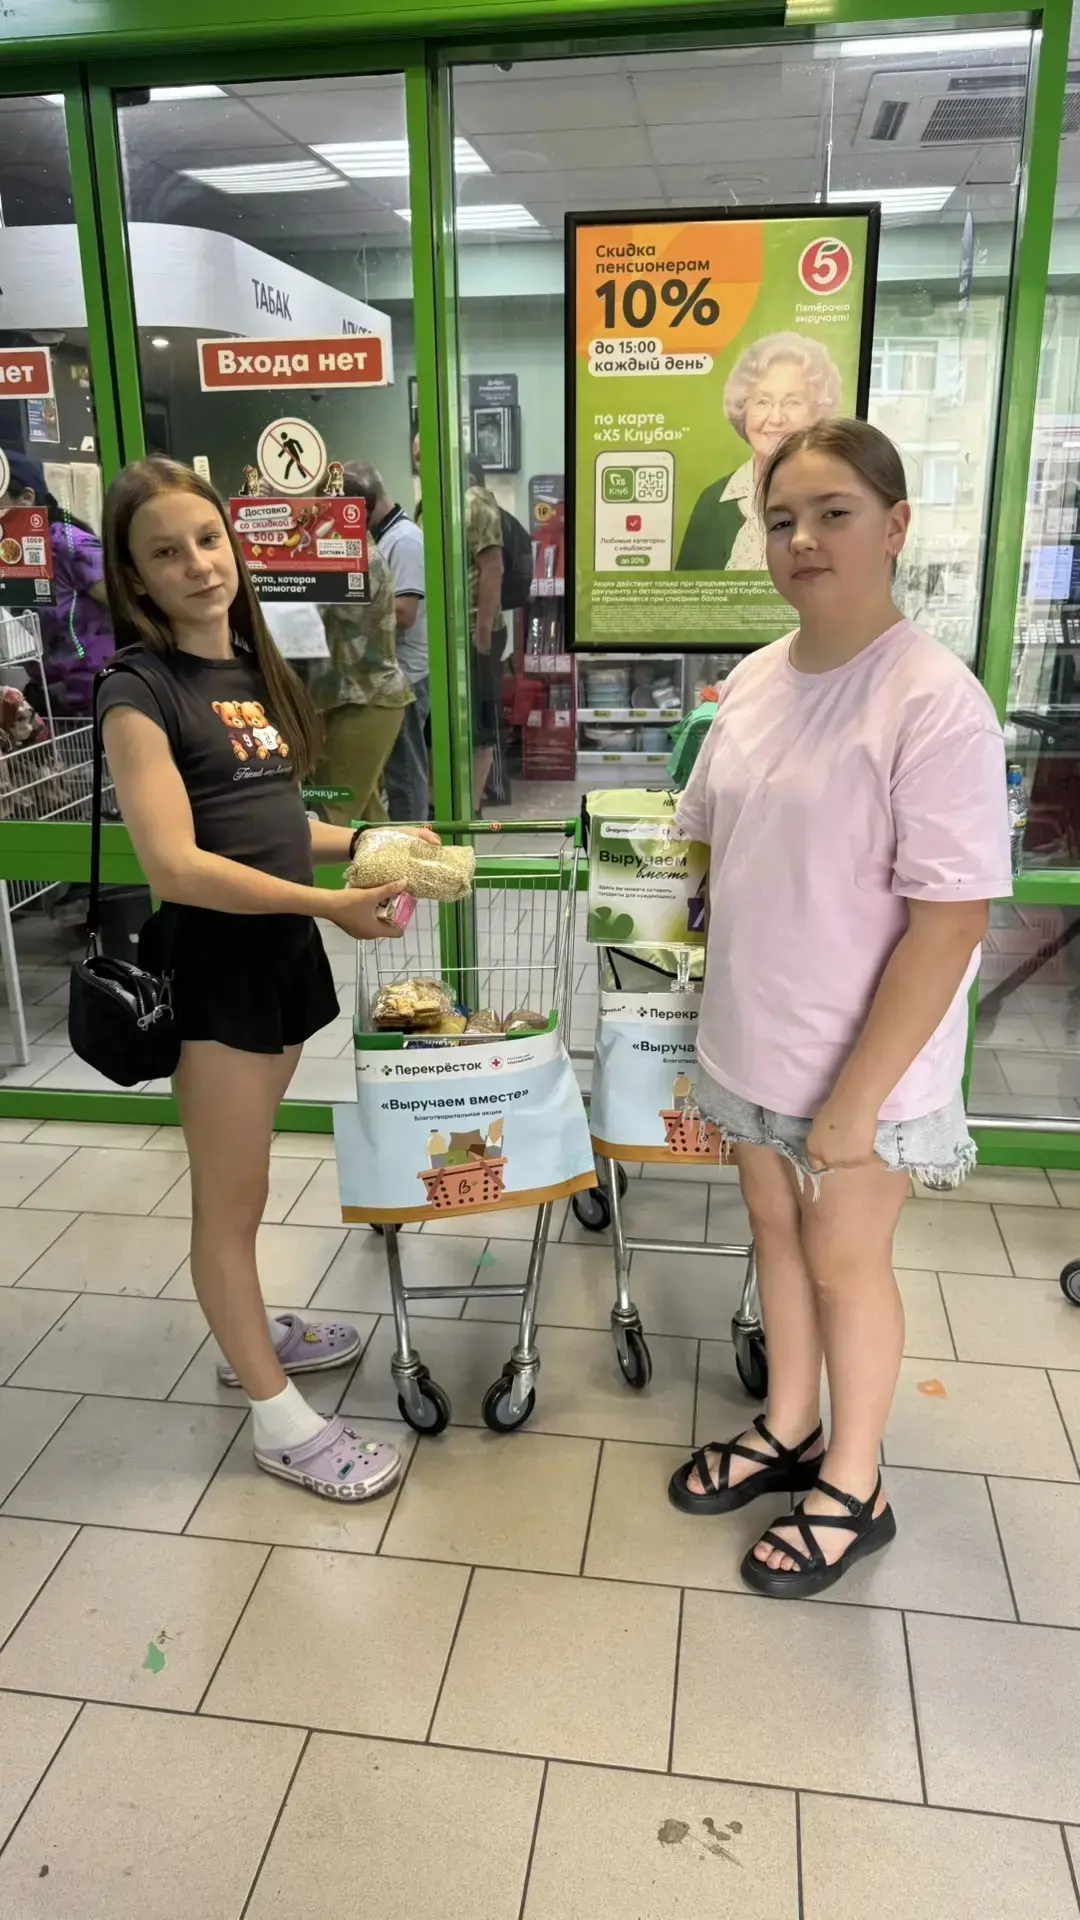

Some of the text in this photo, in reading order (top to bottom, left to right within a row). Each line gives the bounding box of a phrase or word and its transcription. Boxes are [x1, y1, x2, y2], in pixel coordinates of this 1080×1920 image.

[596, 244, 656, 258] Скидка
[595, 260, 710, 275] пенсионерам
[811, 244, 839, 285] 5
[251, 278, 293, 321] ТАБАК
[595, 278, 720, 329] 10%
[795, 303, 851, 314] Пятёрочка
[794, 313, 850, 324] выручает!
[595, 341, 656, 355] до 15:00
[217, 350, 368, 377] Входа нет
[595, 356, 660, 373] каждый
[594, 413, 665, 427] по карте
[609, 488, 629, 496] Клуб
[245, 506, 288, 517] Доставка
[251, 519, 291, 529] скидкой
[253, 532, 274, 542] 500
[600, 537, 632, 545] Любимые
[621, 557, 630, 565] до
[252, 574, 316, 586] бота, которая
[616, 580, 653, 588] действует
[701, 588, 724, 596] карты
[242, 733, 253, 747] 9
[302, 789, 339, 799] рочку»
[599, 851, 687, 868] Выручаем
[636, 864, 689, 881] вместе
[650, 1008, 698, 1020] Перекр
[632, 1040, 697, 1055] «Выруча
[395, 1060, 482, 1077] Перекрёсток
[380, 1087, 530, 1113] «Выручаем вместе»
[414, 1108, 503, 1122] Благотворительная акция
[300, 1474, 370, 1499] crocs
